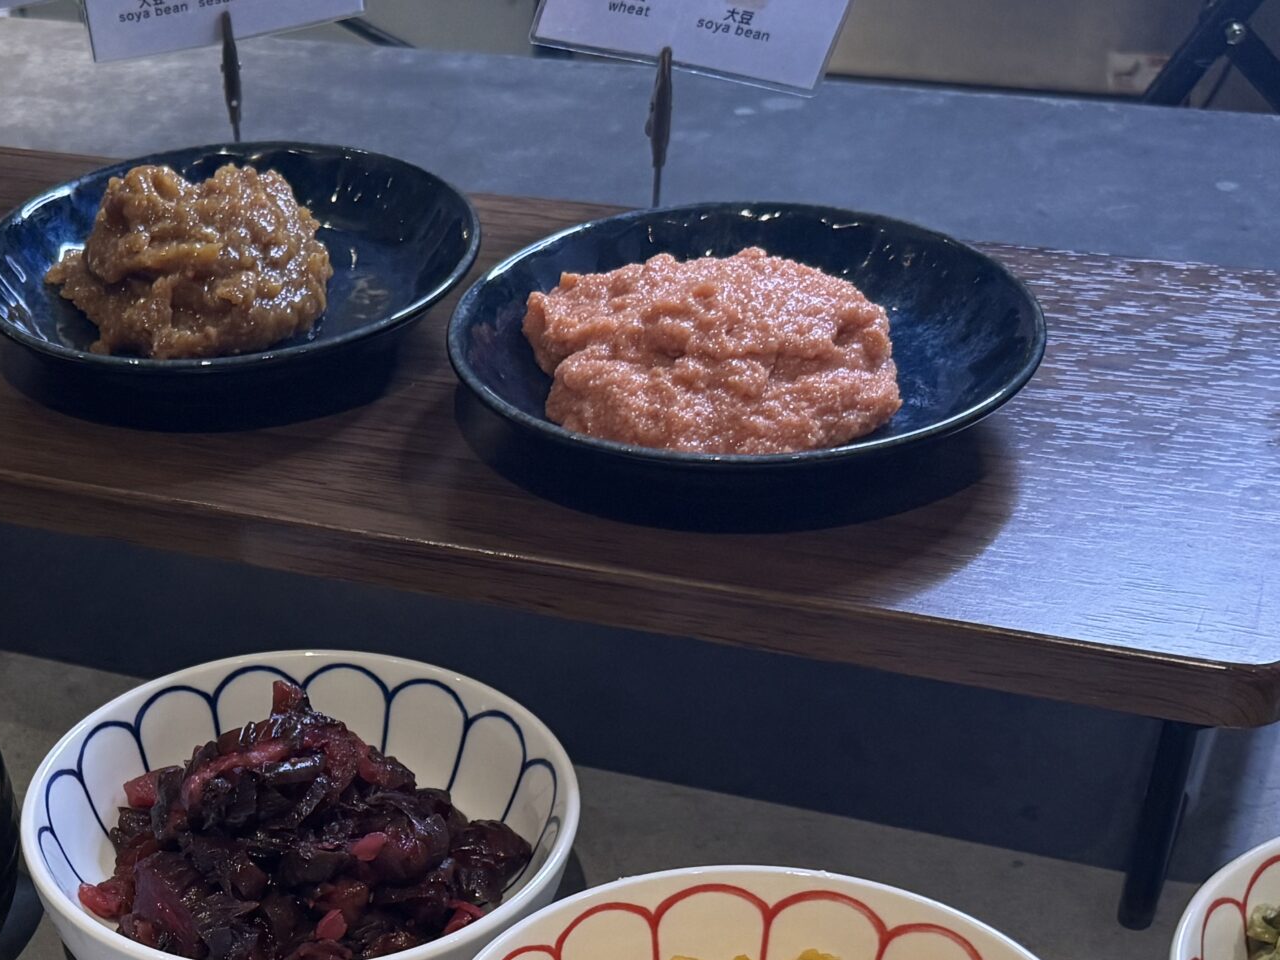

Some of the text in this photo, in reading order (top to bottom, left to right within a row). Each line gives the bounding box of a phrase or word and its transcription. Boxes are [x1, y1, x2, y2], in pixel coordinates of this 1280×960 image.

[119, 3, 189, 22] soya bean
[608, 2, 651, 17] wheat
[724, 8, 755, 26] 大豆
[696, 18, 770, 42] soya bean
